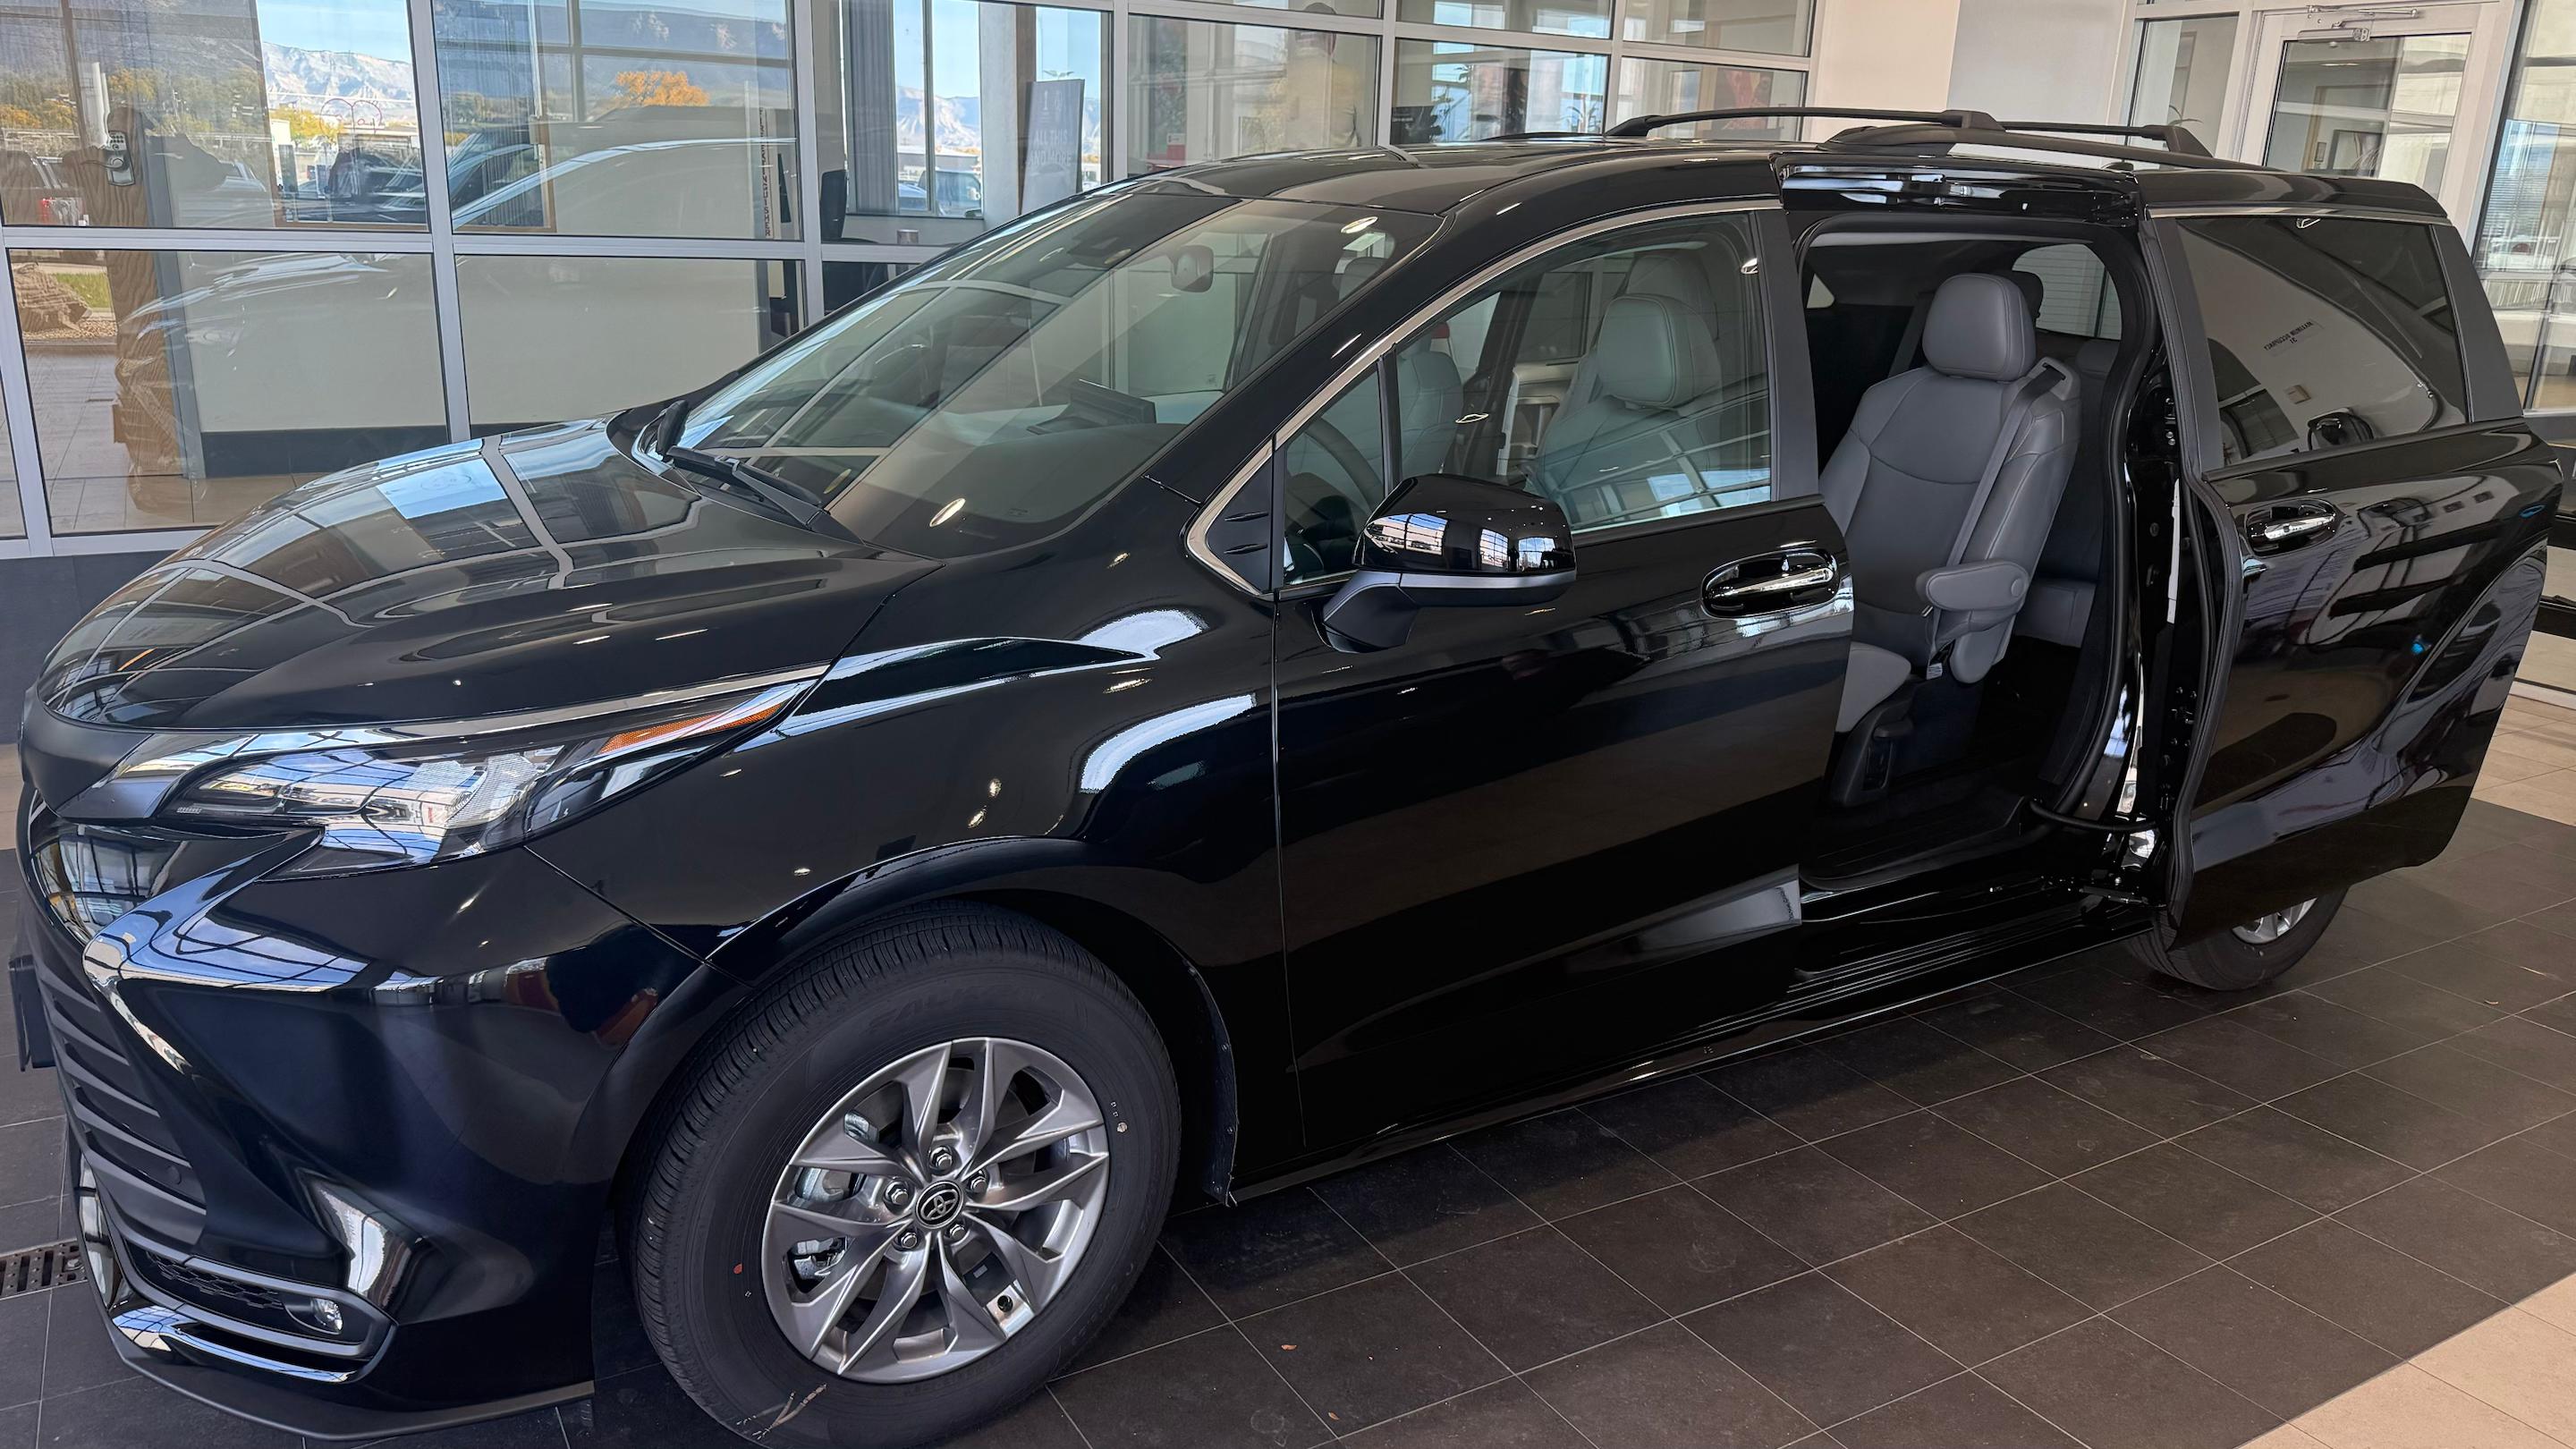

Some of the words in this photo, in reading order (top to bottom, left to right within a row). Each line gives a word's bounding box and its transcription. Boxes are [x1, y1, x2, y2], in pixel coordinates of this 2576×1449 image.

[1033, 130, 1048, 146] ALL
[1049, 129, 1068, 144] THIS
[1029, 149, 1046, 165] AND
[1047, 149, 1072, 166] MORE
